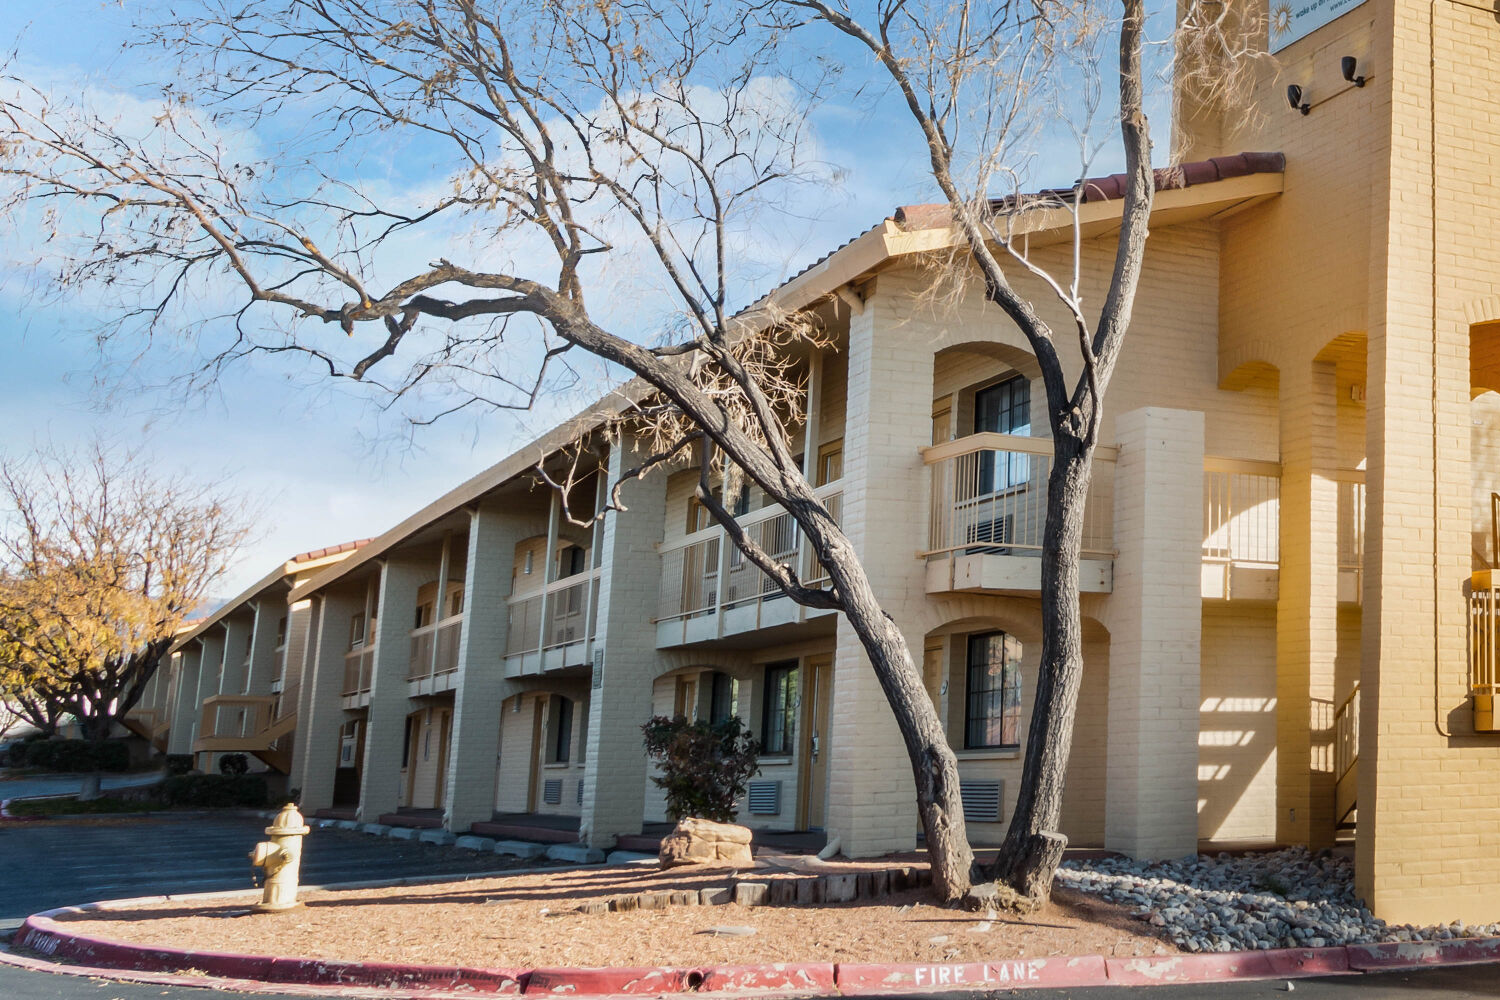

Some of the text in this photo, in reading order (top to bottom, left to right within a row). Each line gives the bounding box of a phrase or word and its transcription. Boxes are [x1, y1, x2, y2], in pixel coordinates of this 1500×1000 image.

[1296, 7, 1310, 18] wake
[1310, 3, 1318, 11] up
[915, 962, 1041, 986] FIRE LANE
